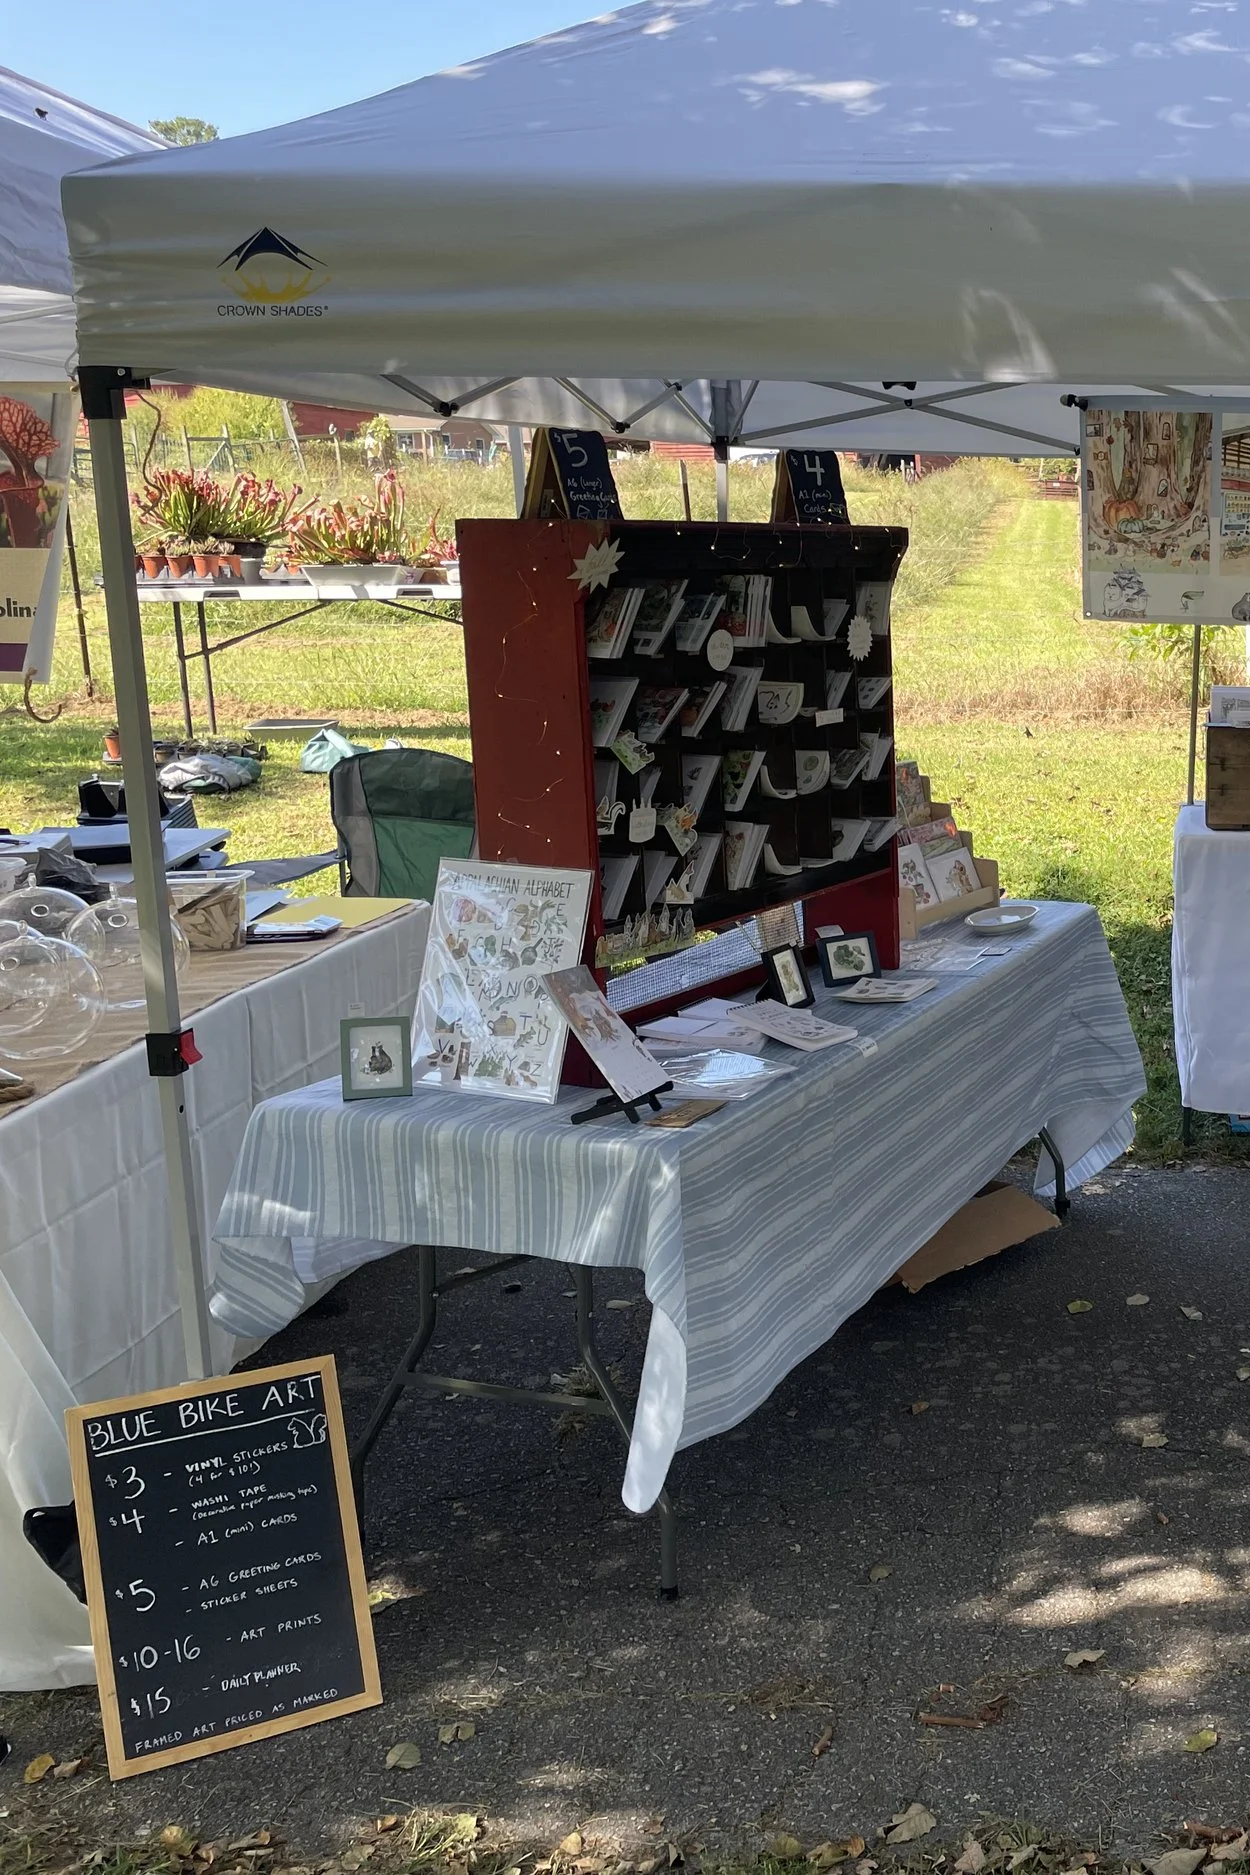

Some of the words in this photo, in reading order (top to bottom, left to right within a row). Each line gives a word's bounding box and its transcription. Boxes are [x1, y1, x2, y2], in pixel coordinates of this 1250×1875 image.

[217, 305, 266, 317] CROWN
[799, 489, 810, 500] A1
[803, 503, 827, 513] Cards
[523, 878, 575, 899] ALPHABET
[556, 903, 566, 917] E
[506, 981, 518, 996] N
[519, 1014, 533, 1030] T
[438, 1038, 450, 1054] V
[506, 1055, 517, 1072] Y
[530, 1063, 542, 1077] Z
[87, 1411, 162, 1451] BLUE
[178, 1393, 244, 1429] BIKE
[261, 1374, 321, 1410] ART
[105, 1466, 146, 1500] $3
[184, 1456, 228, 1473] VINYL
[232, 1441, 289, 1464] STICKERS
[210, 1470, 223, 1481] for
[109, 1508, 146, 1534] $4
[191, 1494, 229, 1510] WASHI
[238, 1484, 268, 1498] TAPE
[240, 1496, 263, 1511] paper
[197, 1530, 219, 1546] A1
[225, 1521, 255, 1539] (mini)
[261, 1512, 298, 1528] CARDS
[115, 1578, 156, 1613] $5
[199, 1575, 220, 1591] A6
[228, 1561, 281, 1583] GREETING
[284, 1551, 322, 1567] CARDS
[200, 1591, 248, 1611] STICKER
[255, 1578, 299, 1596] SHEETS
[240, 1626, 267, 1643] ART
[277, 1613, 322, 1633] PRINTS
[130, 1686, 171, 1720] $15
[221, 1672, 251, 1691] DAILY
[253, 1662, 301, 1683] PLANNER
[134, 1730, 183, 1754] FRAMED
[192, 1721, 217, 1737] ART
[224, 1709, 263, 1728] PRICED
[271, 1702, 286, 1714] AS
[293, 1687, 339, 1708] MARKED
